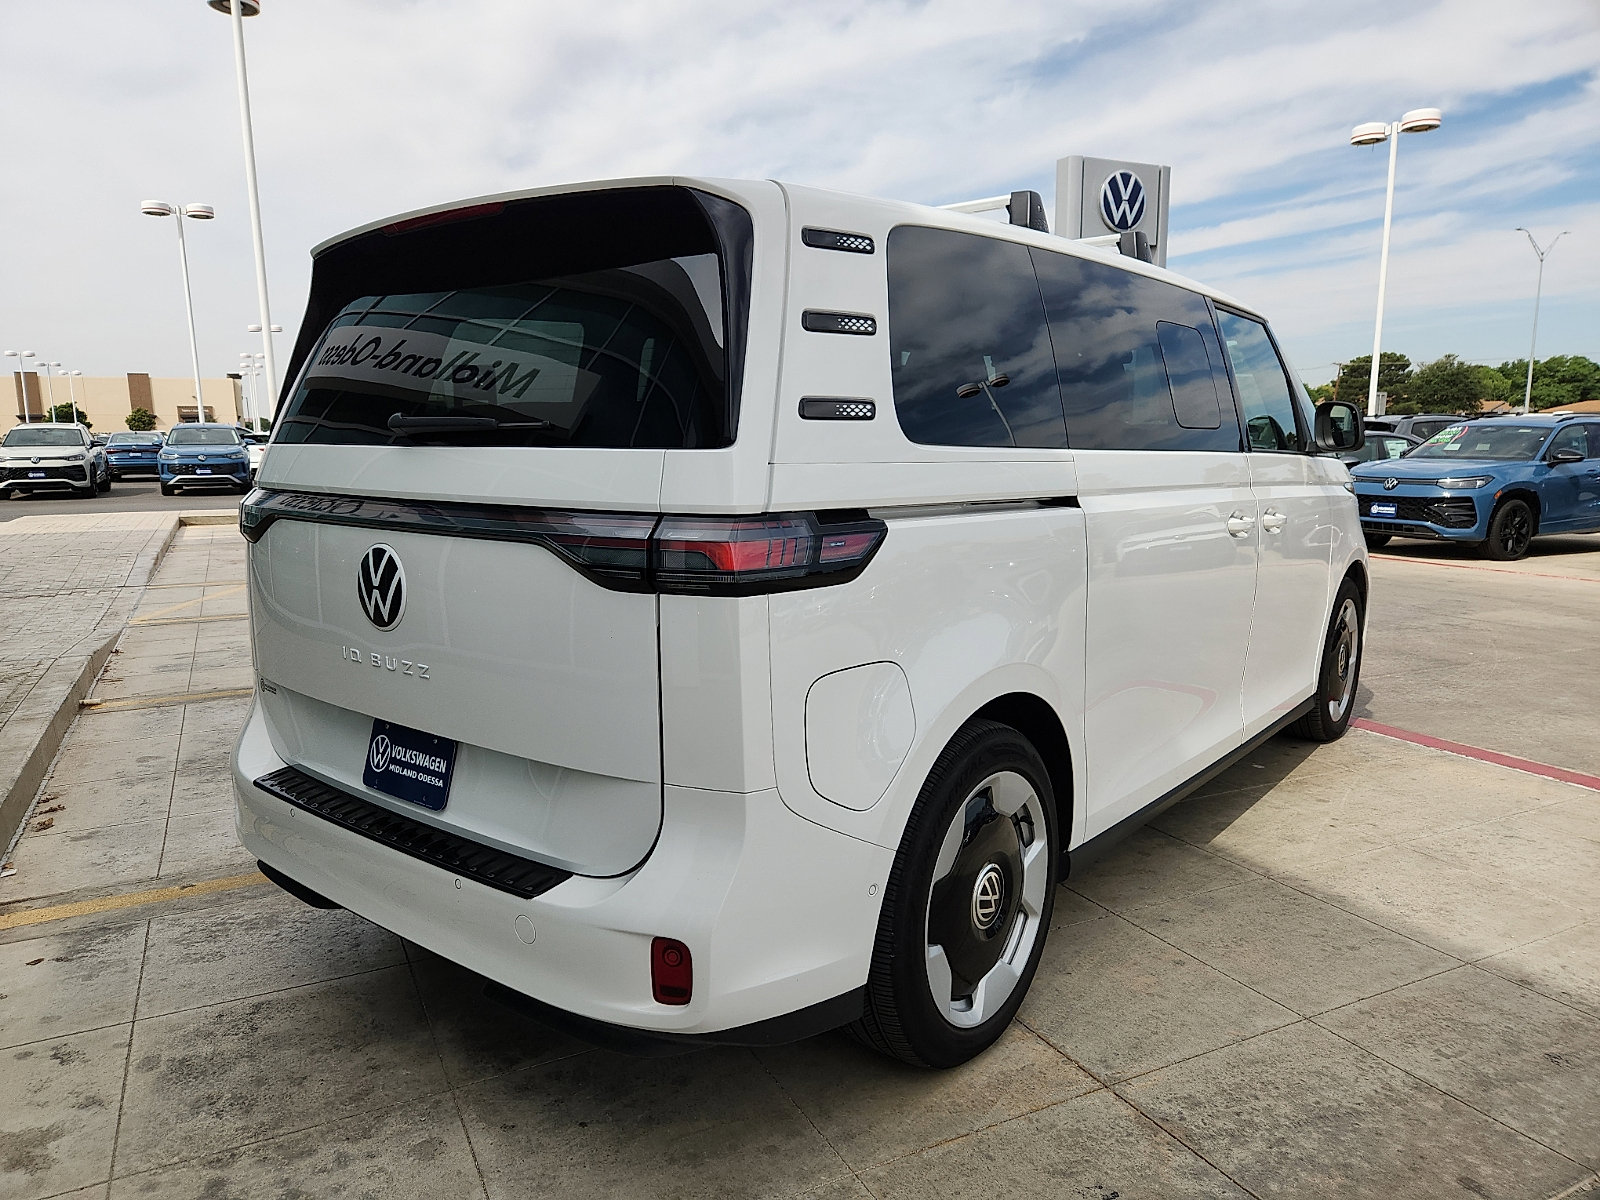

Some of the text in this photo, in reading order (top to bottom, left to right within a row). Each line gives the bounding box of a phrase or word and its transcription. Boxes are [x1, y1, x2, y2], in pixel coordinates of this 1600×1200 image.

[370, 652, 430, 679] BUZZ
[391, 744, 447, 774] VOLKSWAGEN
[388, 763, 443, 788] MIDLAND ODESSA
